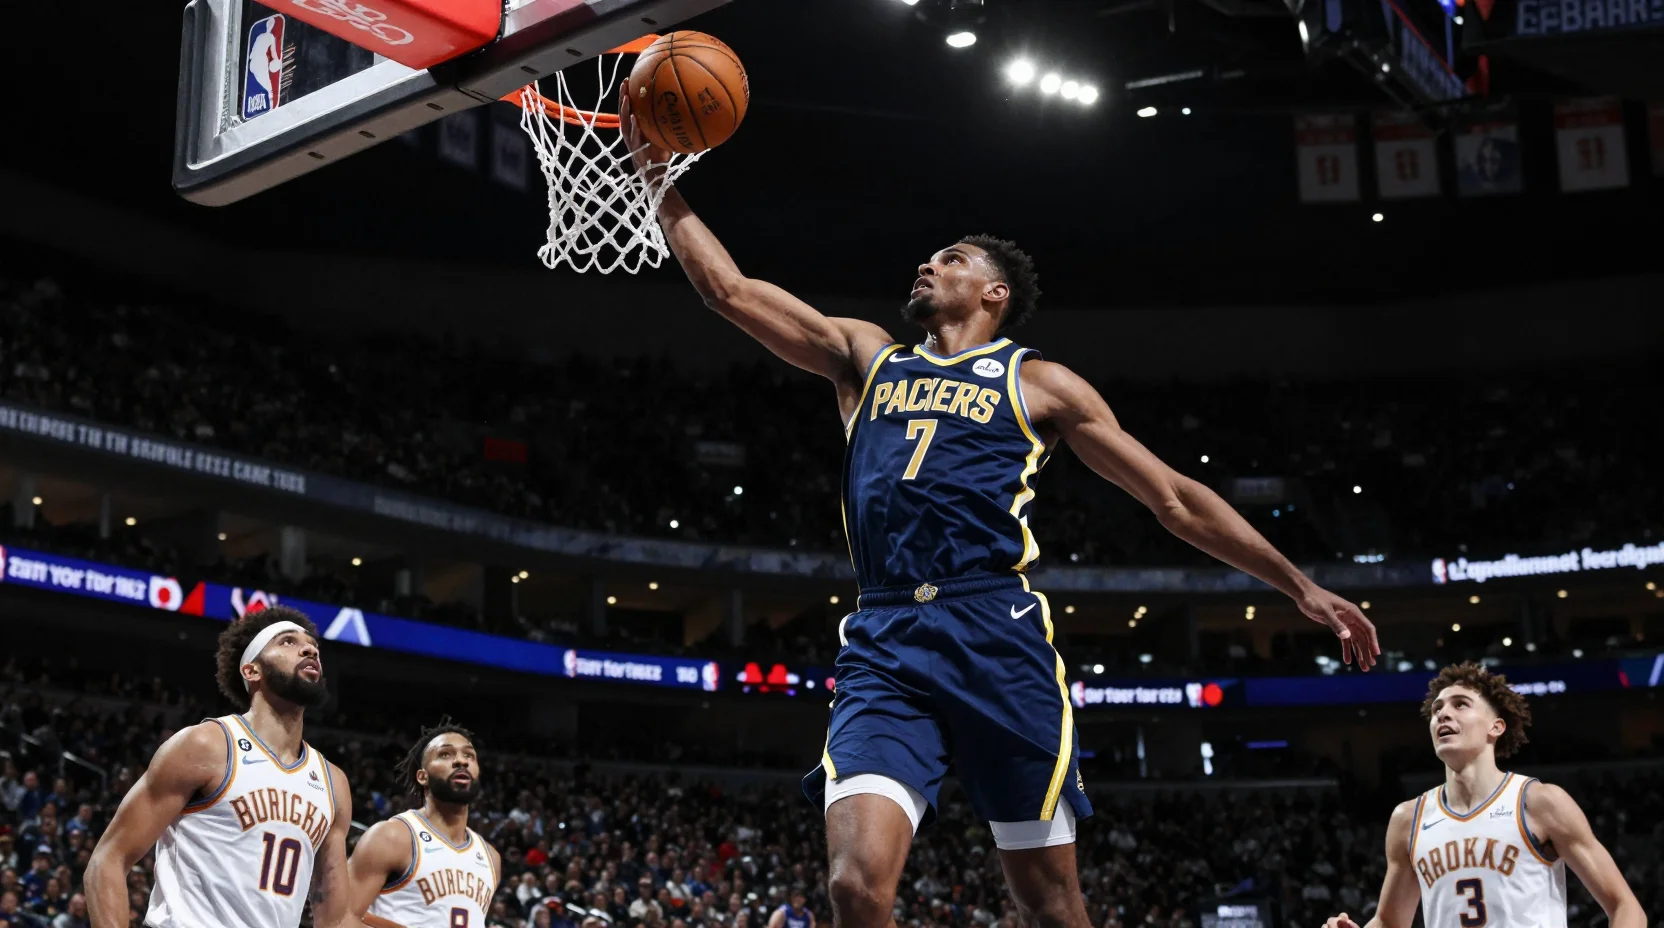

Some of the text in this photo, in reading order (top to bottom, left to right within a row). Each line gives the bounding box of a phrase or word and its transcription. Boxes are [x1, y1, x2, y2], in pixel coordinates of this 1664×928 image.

[902, 419, 938, 480] 7
[259, 831, 302, 897] 10
[1455, 877, 1488, 928] 3
